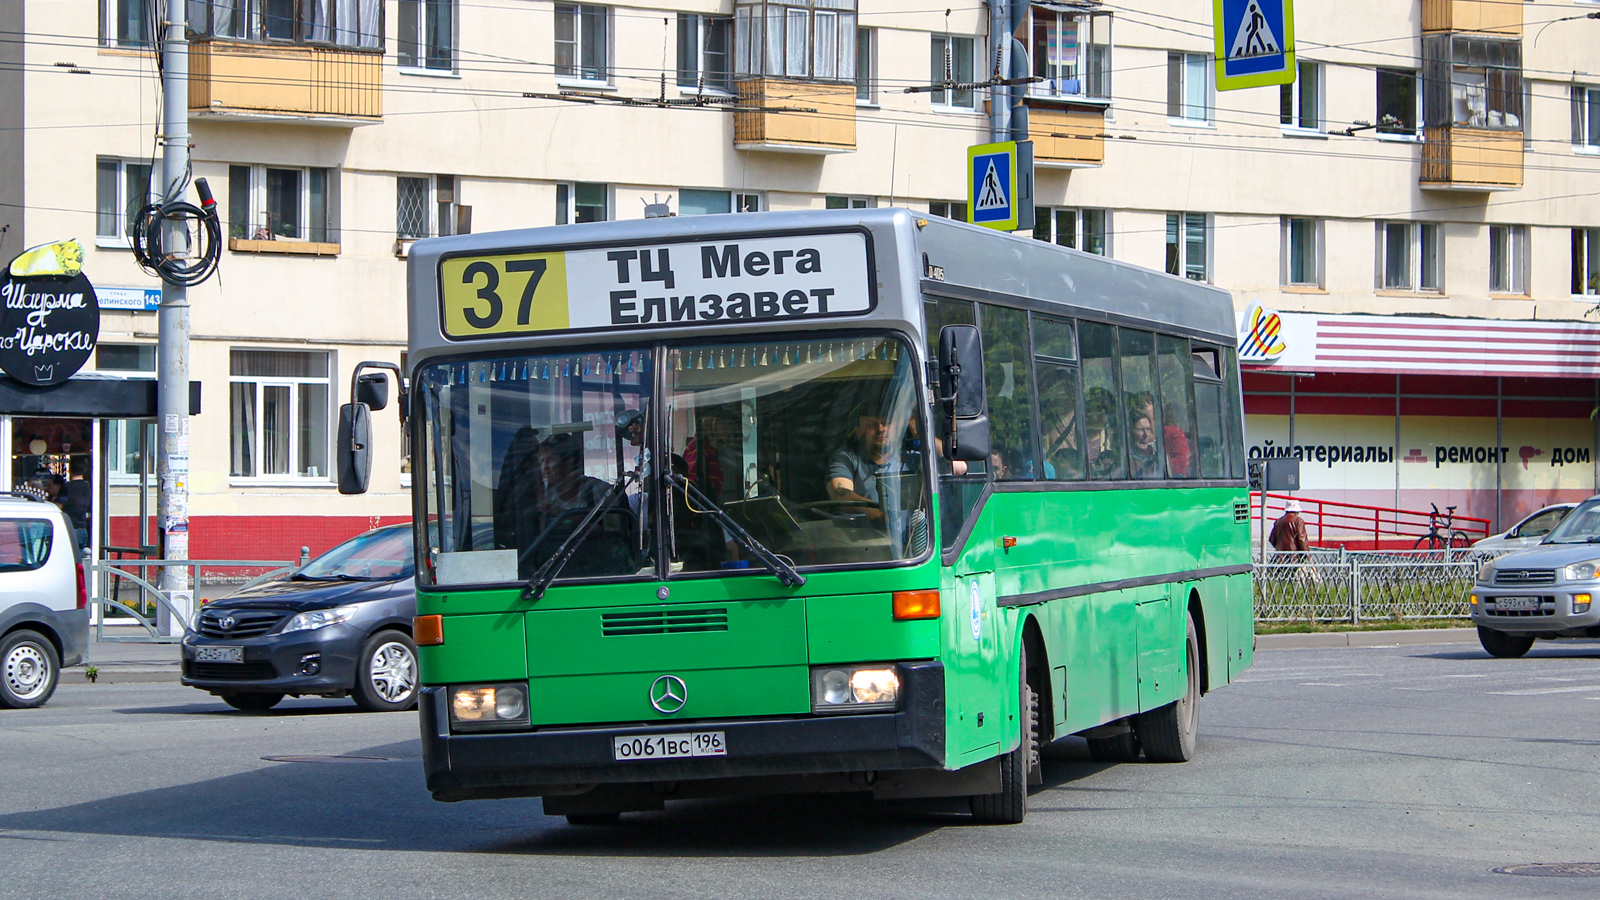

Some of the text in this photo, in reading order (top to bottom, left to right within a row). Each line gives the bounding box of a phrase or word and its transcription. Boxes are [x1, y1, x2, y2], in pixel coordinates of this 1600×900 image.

[98, 293, 160, 306] елинского 143
[461, 244, 822, 329] 37 ТЦ Мега
[2, 279, 88, 328] Шаурма
[609, 287, 835, 325] Елизавет
[1434, 446, 1510, 468] ремонт
[1550, 446, 1591, 467] дом
[693, 733, 721, 749] 196
